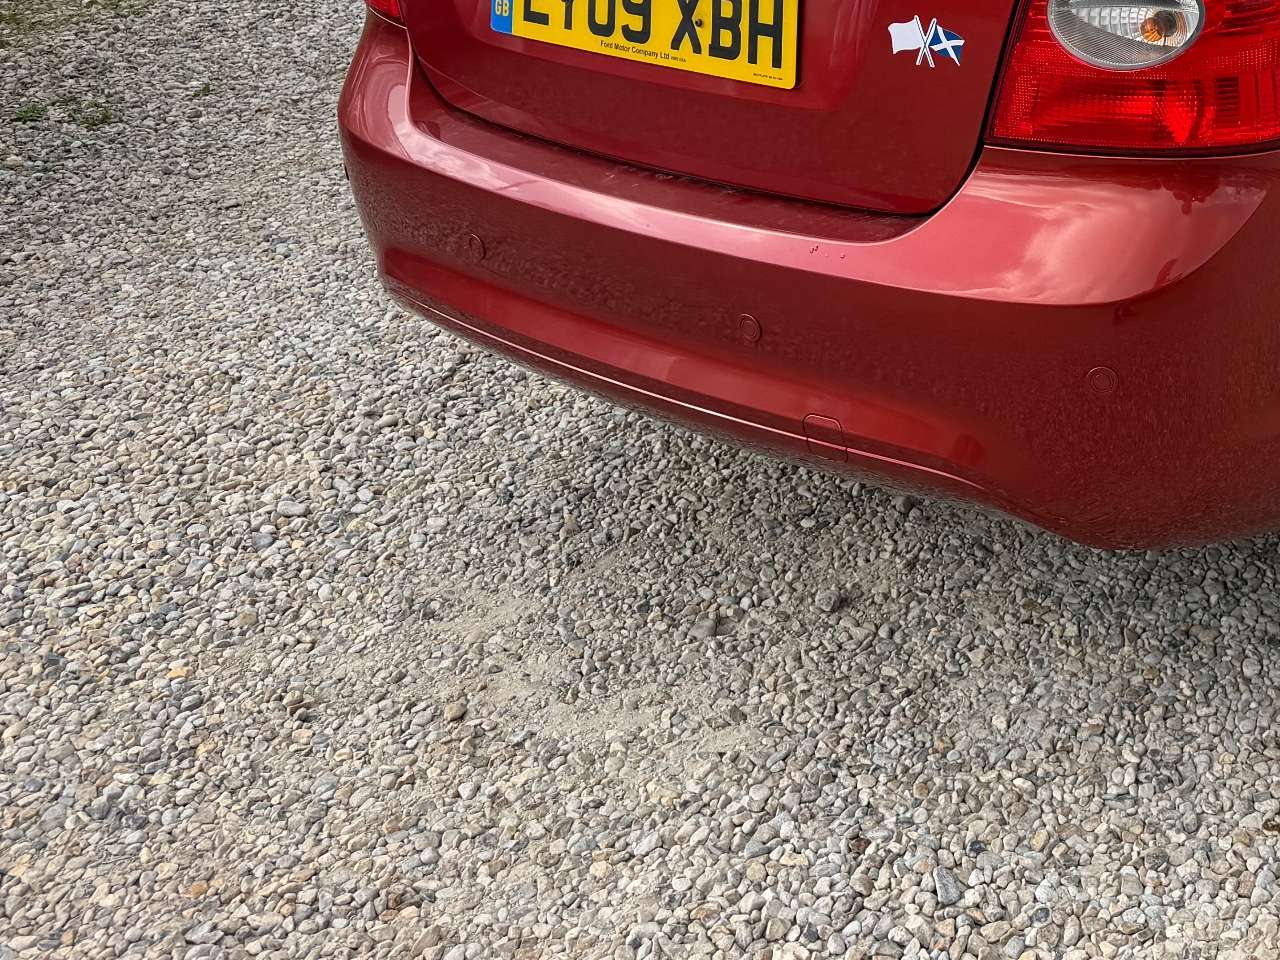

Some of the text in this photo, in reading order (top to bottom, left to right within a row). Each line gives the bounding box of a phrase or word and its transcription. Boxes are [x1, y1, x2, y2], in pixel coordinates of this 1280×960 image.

[600, 40, 614, 49] Ford
[614, 43, 631, 52] Motor
[631, 46, 659, 59] Company
[660, 50, 670, 60] Ltd
